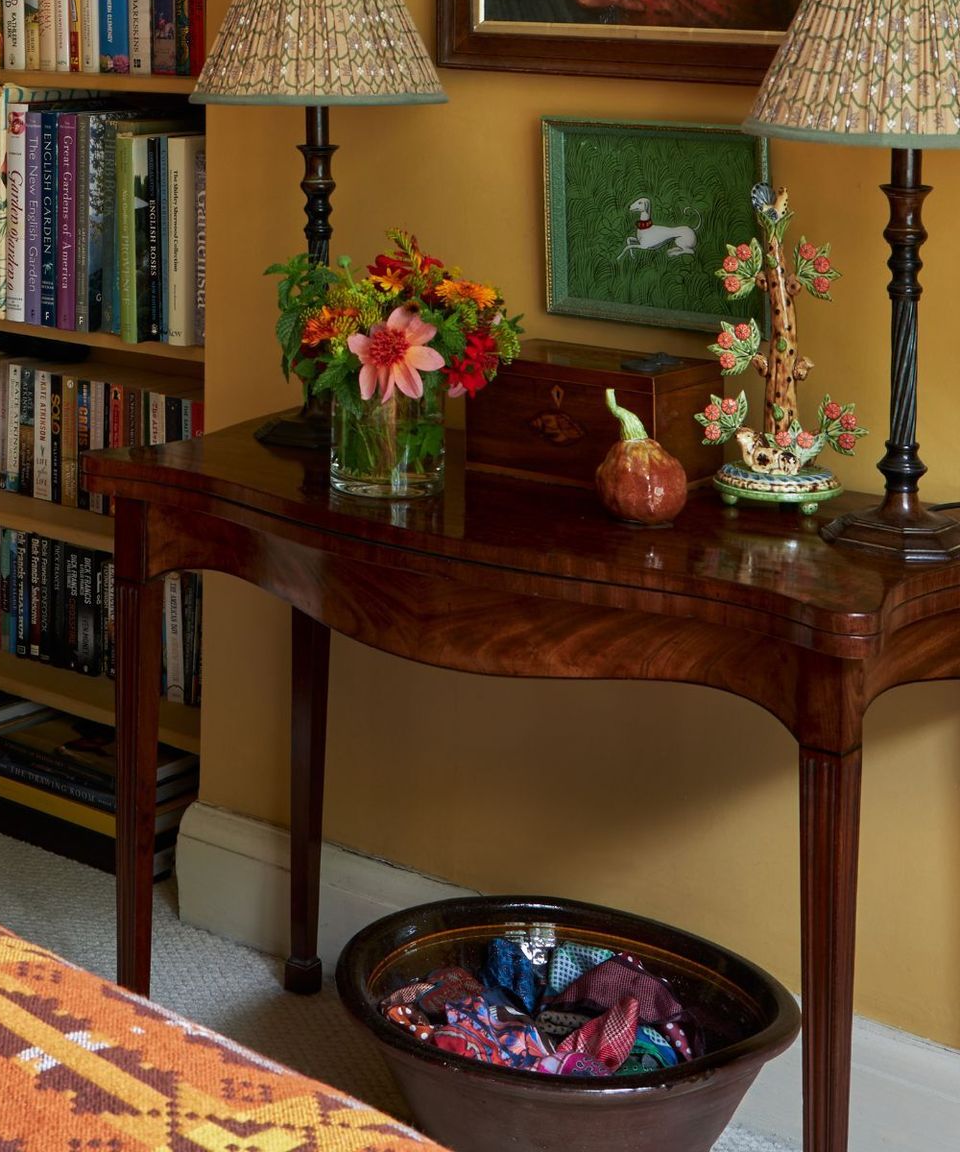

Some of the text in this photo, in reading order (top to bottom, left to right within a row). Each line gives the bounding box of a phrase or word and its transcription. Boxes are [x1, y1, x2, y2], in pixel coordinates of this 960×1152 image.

[8, 170, 23, 225] Garden
[43, 133, 52, 254] ENGLISH GARDEN
[105, 139, 115, 217] HERB BOOK
[27, 136, 39, 292] The New English Garden
[62, 135, 73, 289] Great Gardens of America
[149, 199, 157, 276] ENGLISH ROSES
[122, 234, 130, 305] PROVENCE
[39, 402, 47, 441] ATKINSON
[51, 393, 60, 435] SOLO
[17, 547, 26, 579] Francis
[31, 556, 40, 584] Francis
[32, 538, 40, 555] Dick
[70, 554, 78, 597] DICK FRANCIS
[84, 557, 92, 605] DICK FRANCIS
[9, 766, 96, 802] THE DRAWING ROOM
